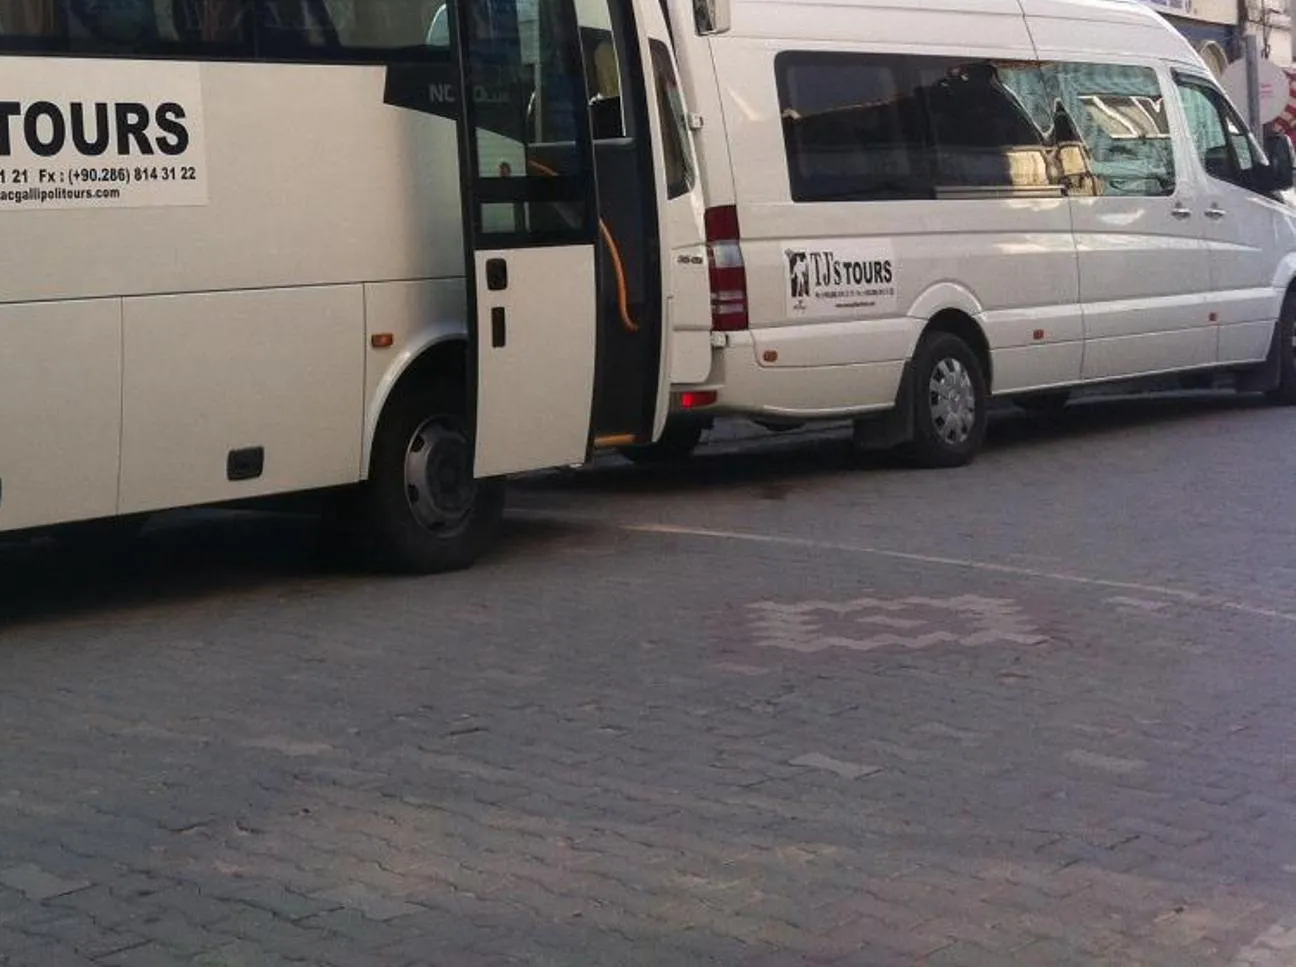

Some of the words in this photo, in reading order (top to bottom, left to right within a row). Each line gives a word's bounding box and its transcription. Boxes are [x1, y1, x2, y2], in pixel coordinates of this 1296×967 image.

[13, 169, 29, 183] 21
[38, 168, 55, 183] Fx
[68, 167, 131, 185] (+90.286)
[134, 167, 158, 181] 814
[161, 166, 177, 181] 31
[180, 165, 197, 180] 22
[842, 259, 893, 285] TOURS
